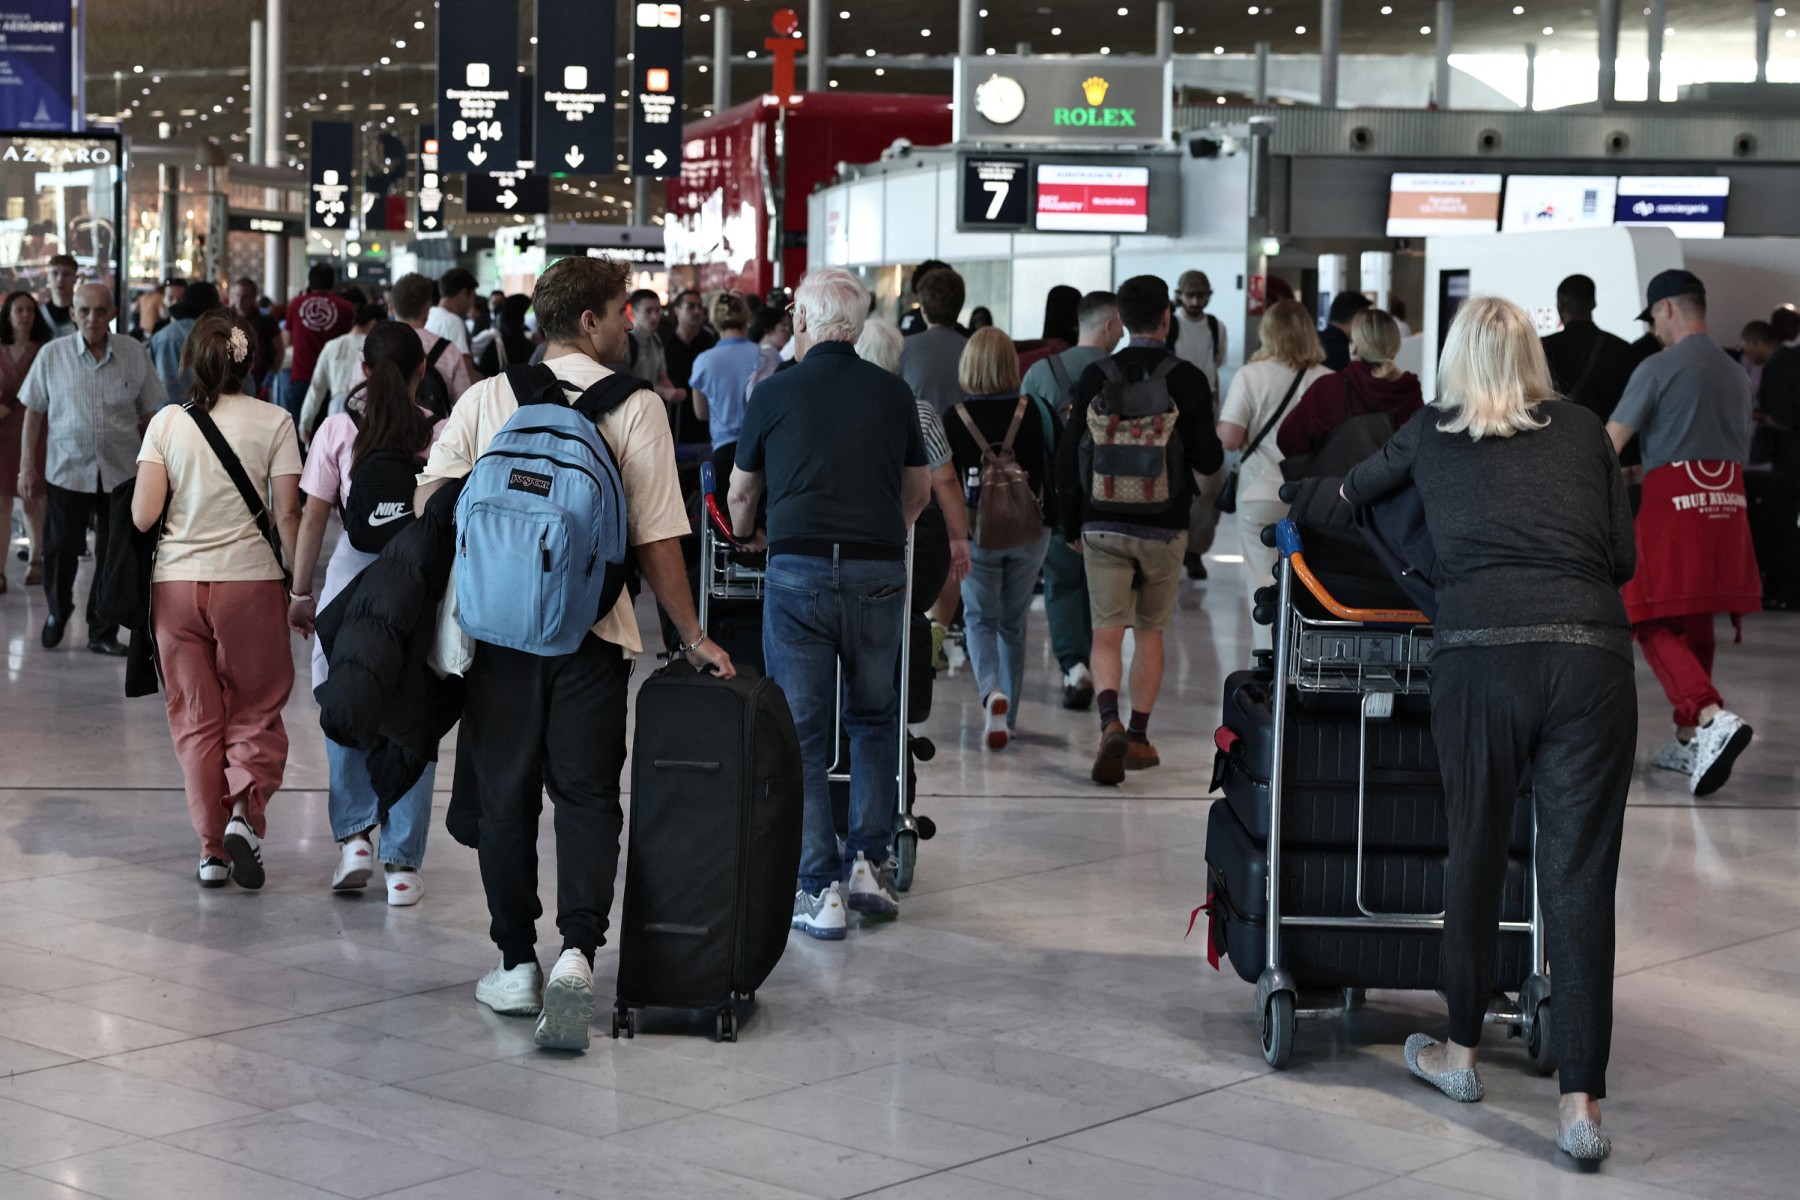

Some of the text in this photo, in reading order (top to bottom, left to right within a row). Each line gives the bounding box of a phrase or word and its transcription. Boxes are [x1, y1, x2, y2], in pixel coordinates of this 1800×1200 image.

[1053, 107, 1137, 127] ROLEX
[452, 120, 503, 141] 8-14
[2, 145, 111, 164] AZZARO
[983, 181, 1009, 220] 7
[510, 473, 551, 490] JANSPORT
[375, 502, 405, 516] NIKE
[1671, 492, 1708, 511] TRUE
